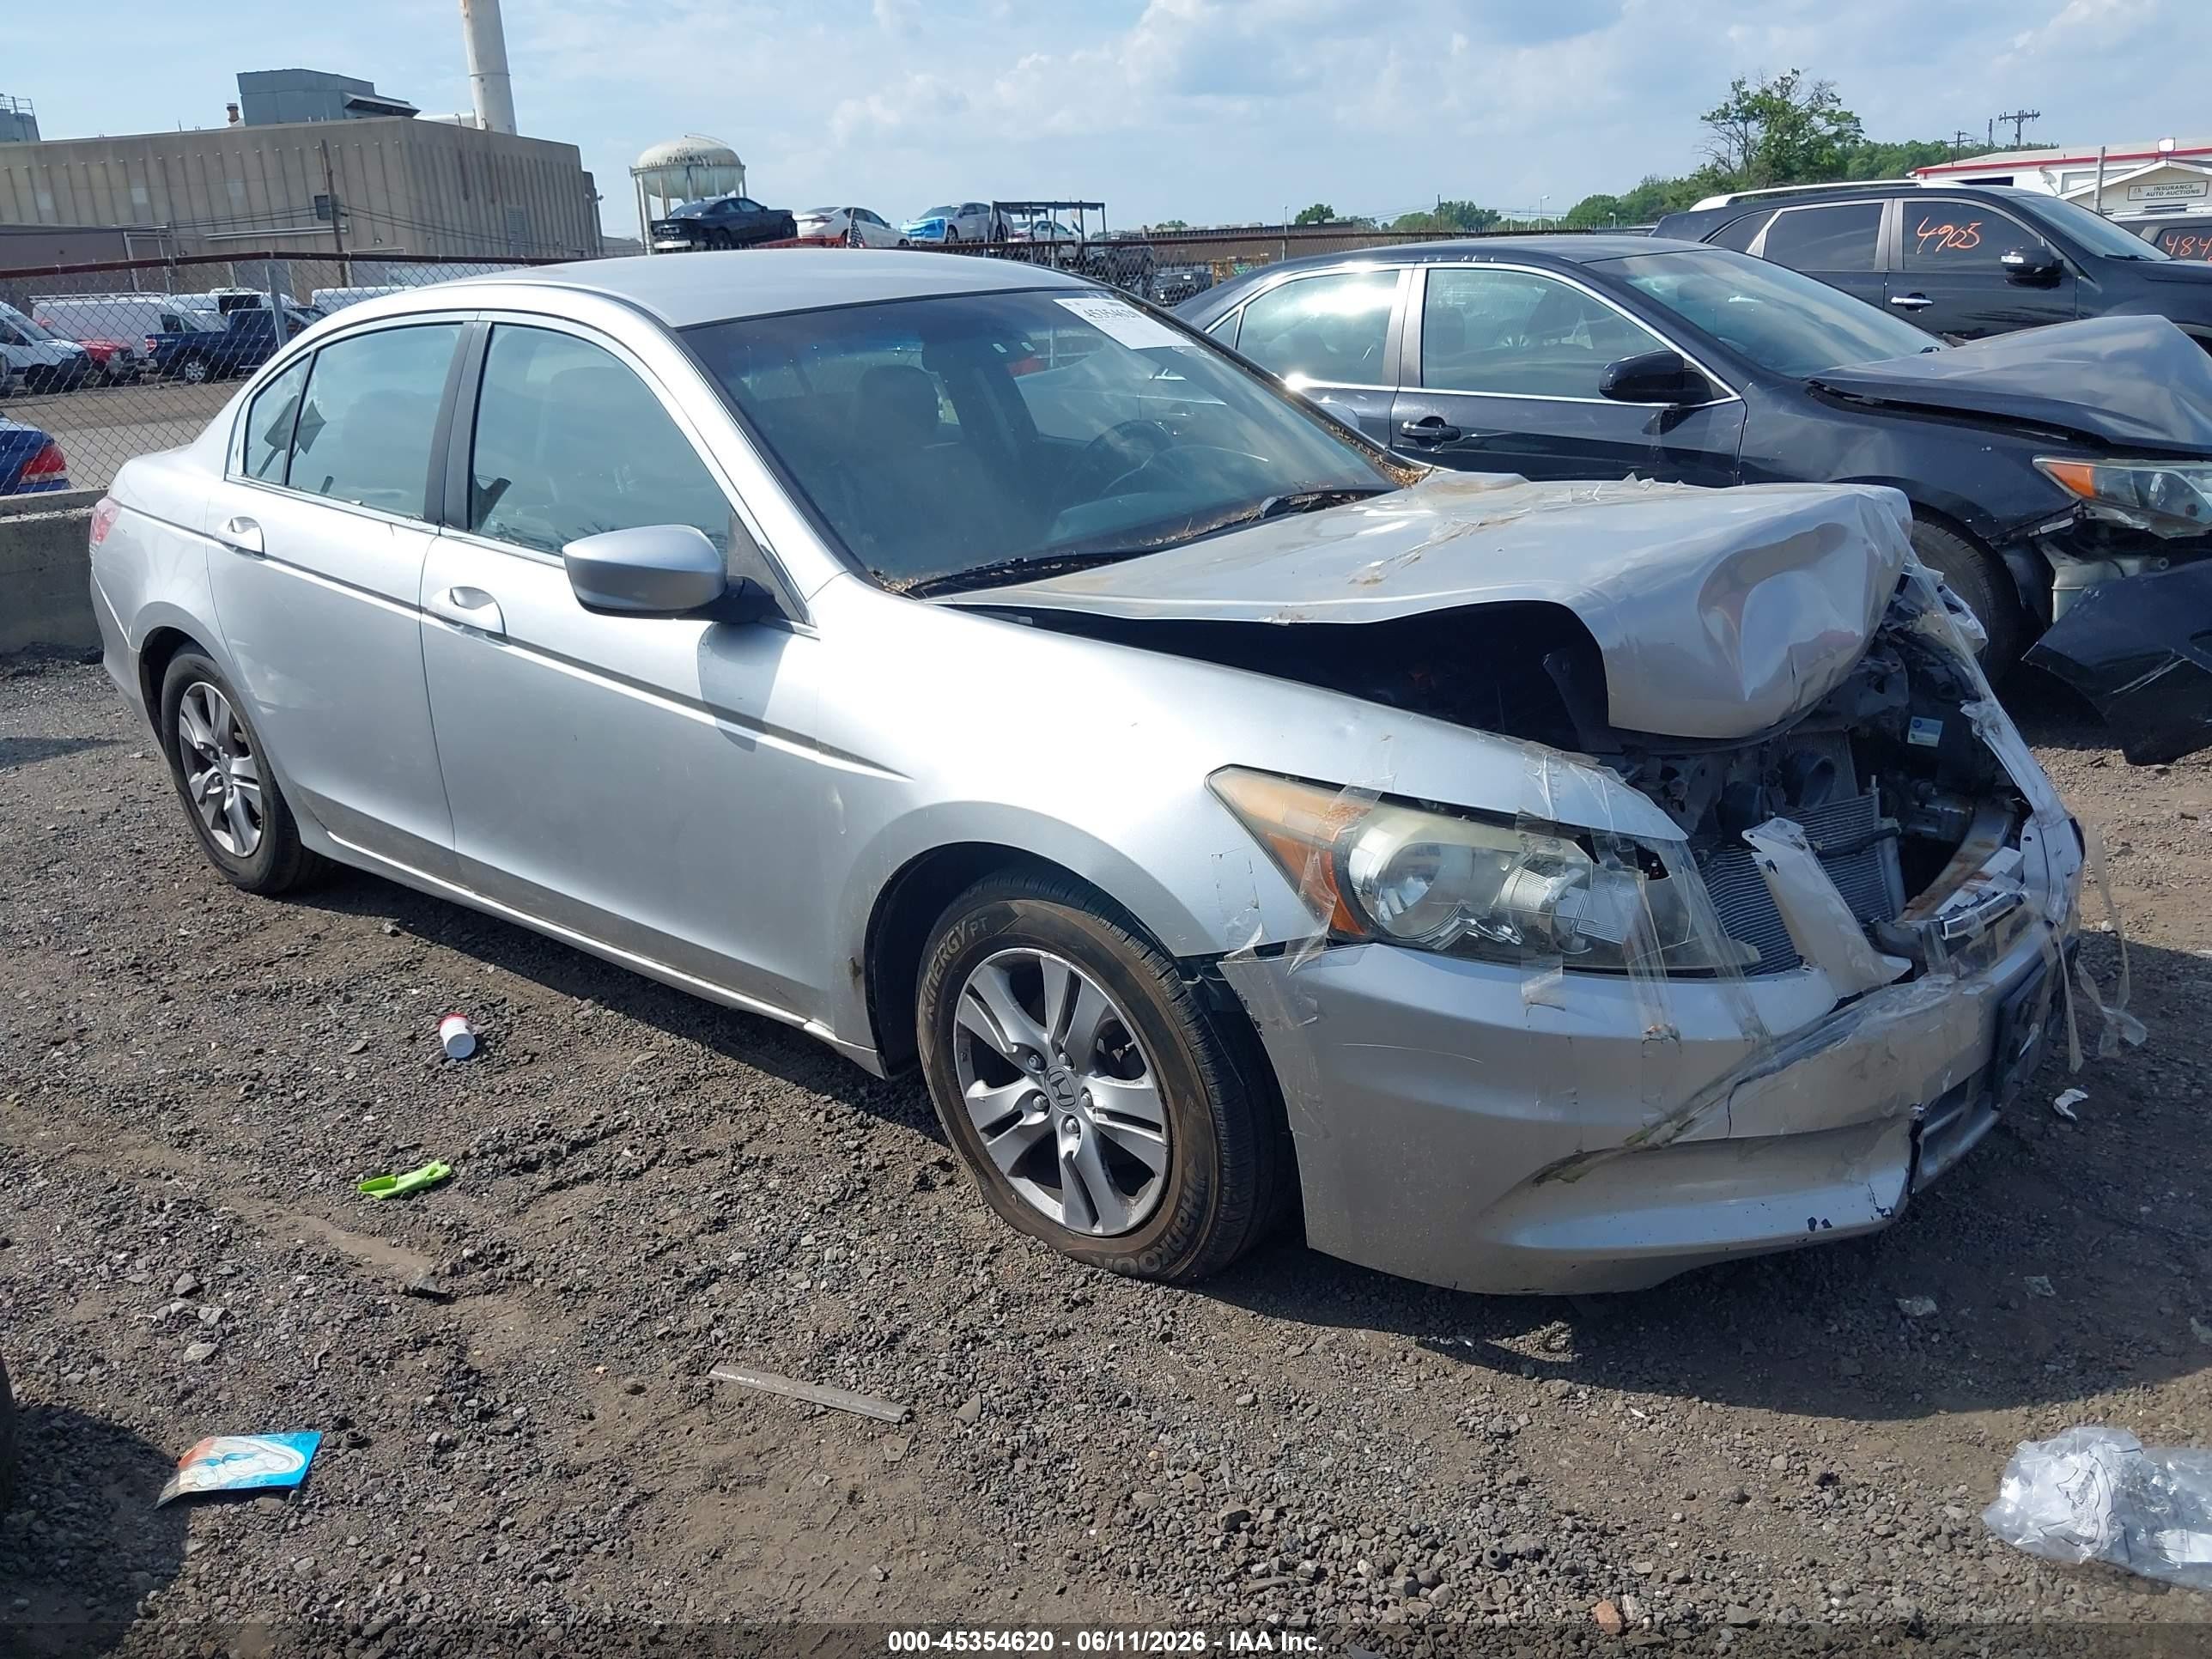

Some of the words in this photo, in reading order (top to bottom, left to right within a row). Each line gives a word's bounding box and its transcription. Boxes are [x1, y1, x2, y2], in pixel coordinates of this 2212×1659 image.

[666, 155, 708, 165] RAHWAY
[921, 921, 967, 1022] KINERGY
[969, 917, 988, 937] PT
